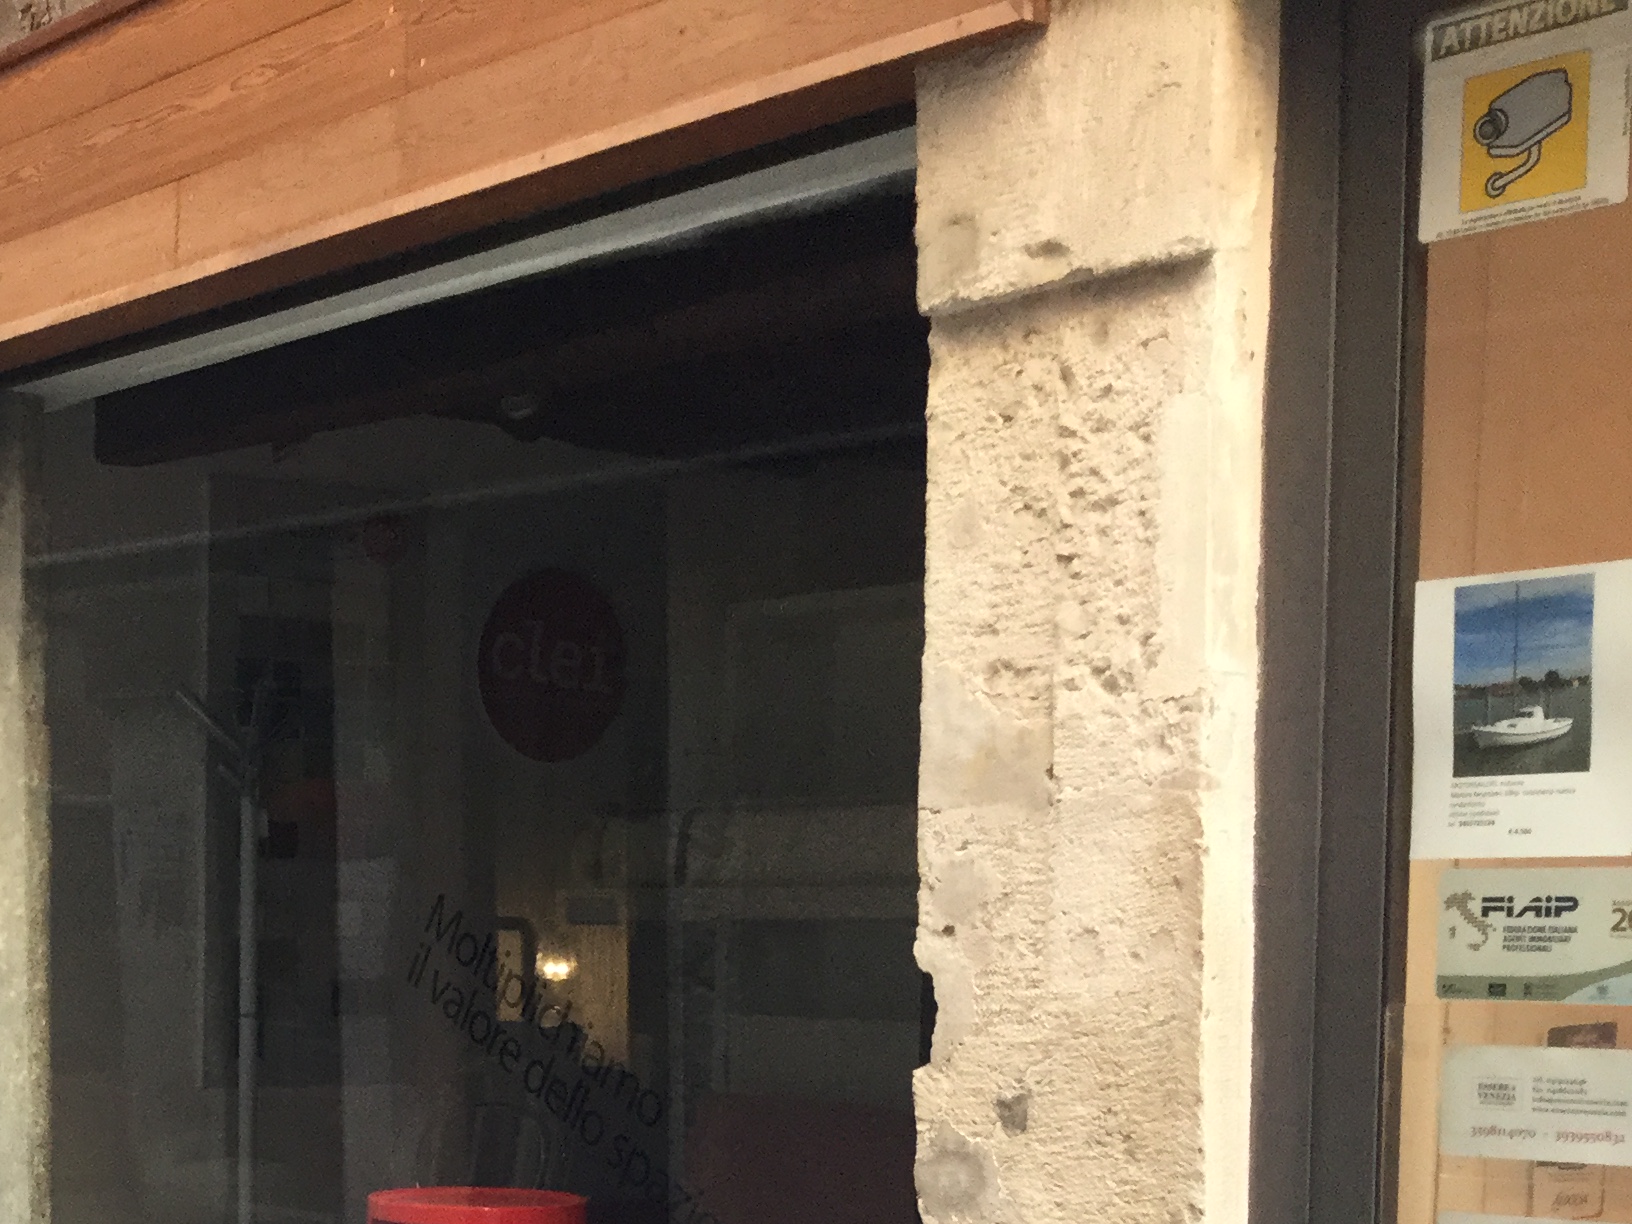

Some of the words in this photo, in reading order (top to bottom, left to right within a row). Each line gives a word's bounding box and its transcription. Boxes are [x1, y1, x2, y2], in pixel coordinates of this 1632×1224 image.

[490, 619, 615, 693] clei
[1610, 906, 1632, 933] 2
[408, 942, 431, 985] il
[430, 970, 522, 1074] valore
[523, 1056, 606, 1146] dello
